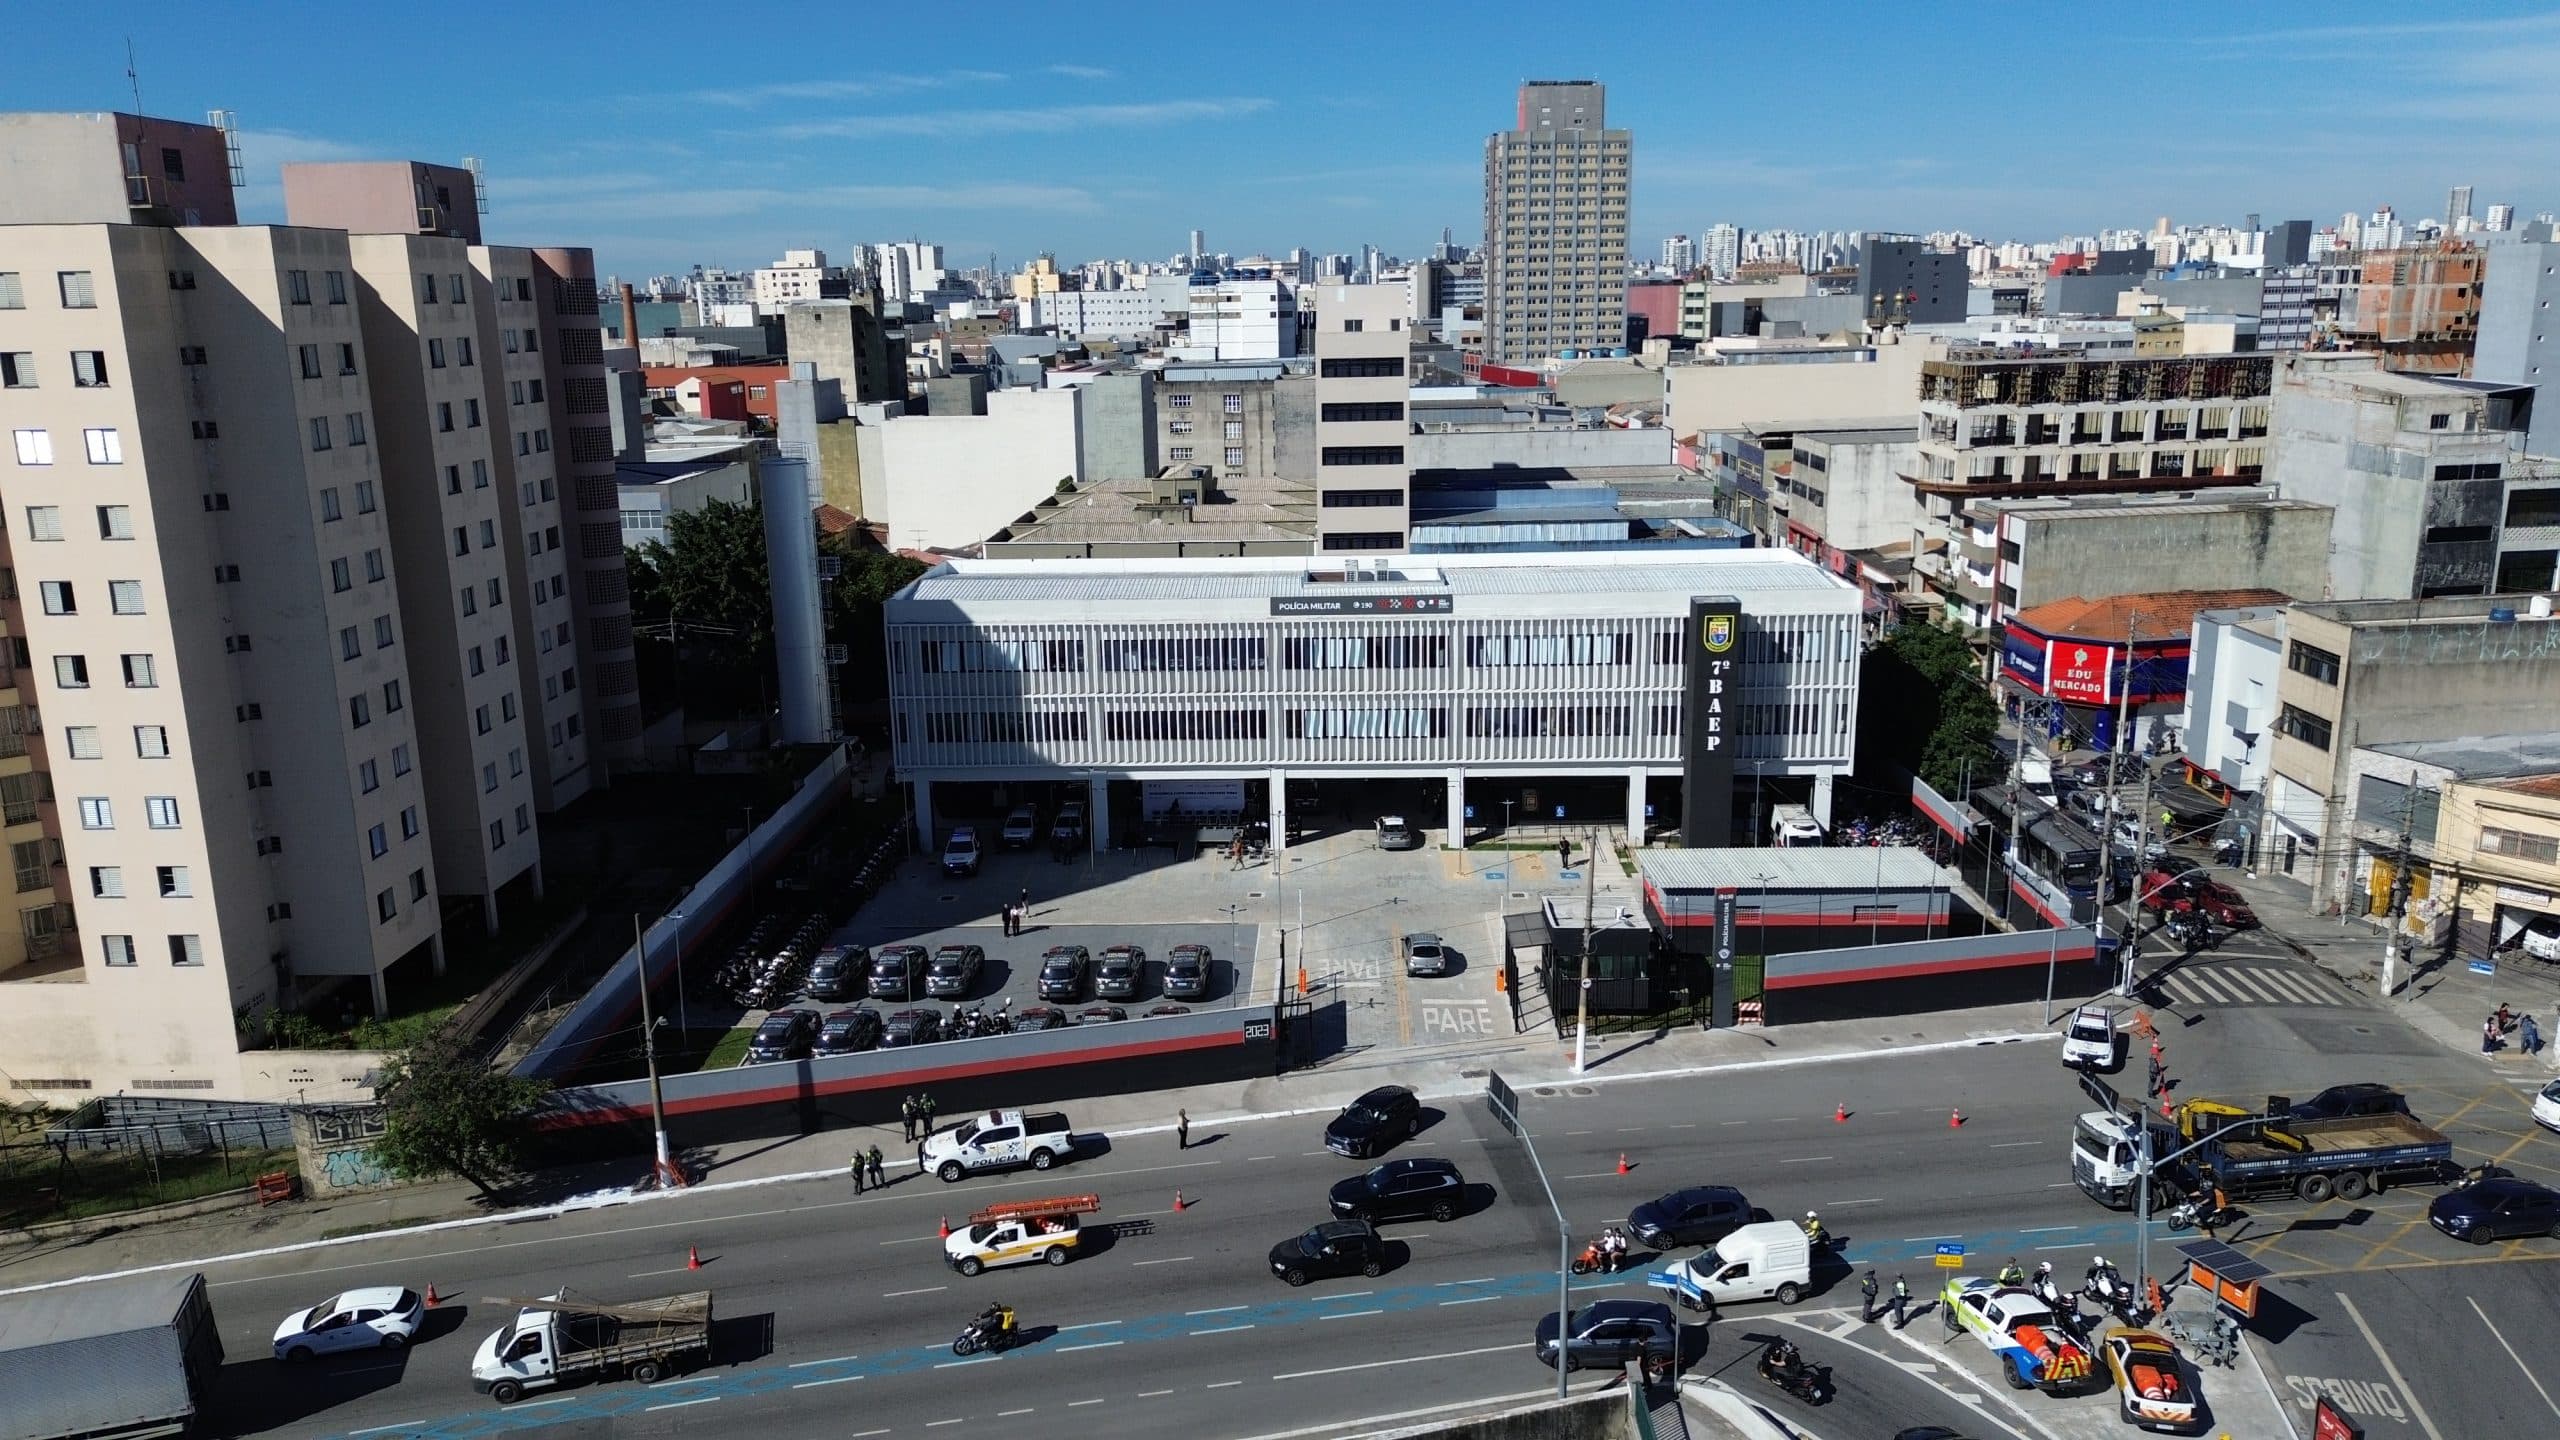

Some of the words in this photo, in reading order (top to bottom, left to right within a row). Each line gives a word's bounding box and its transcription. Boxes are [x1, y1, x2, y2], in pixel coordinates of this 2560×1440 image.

[1279, 601, 1309, 610] POLÍCIA
[1310, 602, 1341, 610] MILITAR
[2067, 669, 2092, 680] EDU
[2053, 680, 2101, 693] MERCADO
[1422, 1007, 1495, 1034] PARE
[1245, 1024, 1269, 1038] 2023
[971, 1153, 1019, 1168] POLÍCIA
